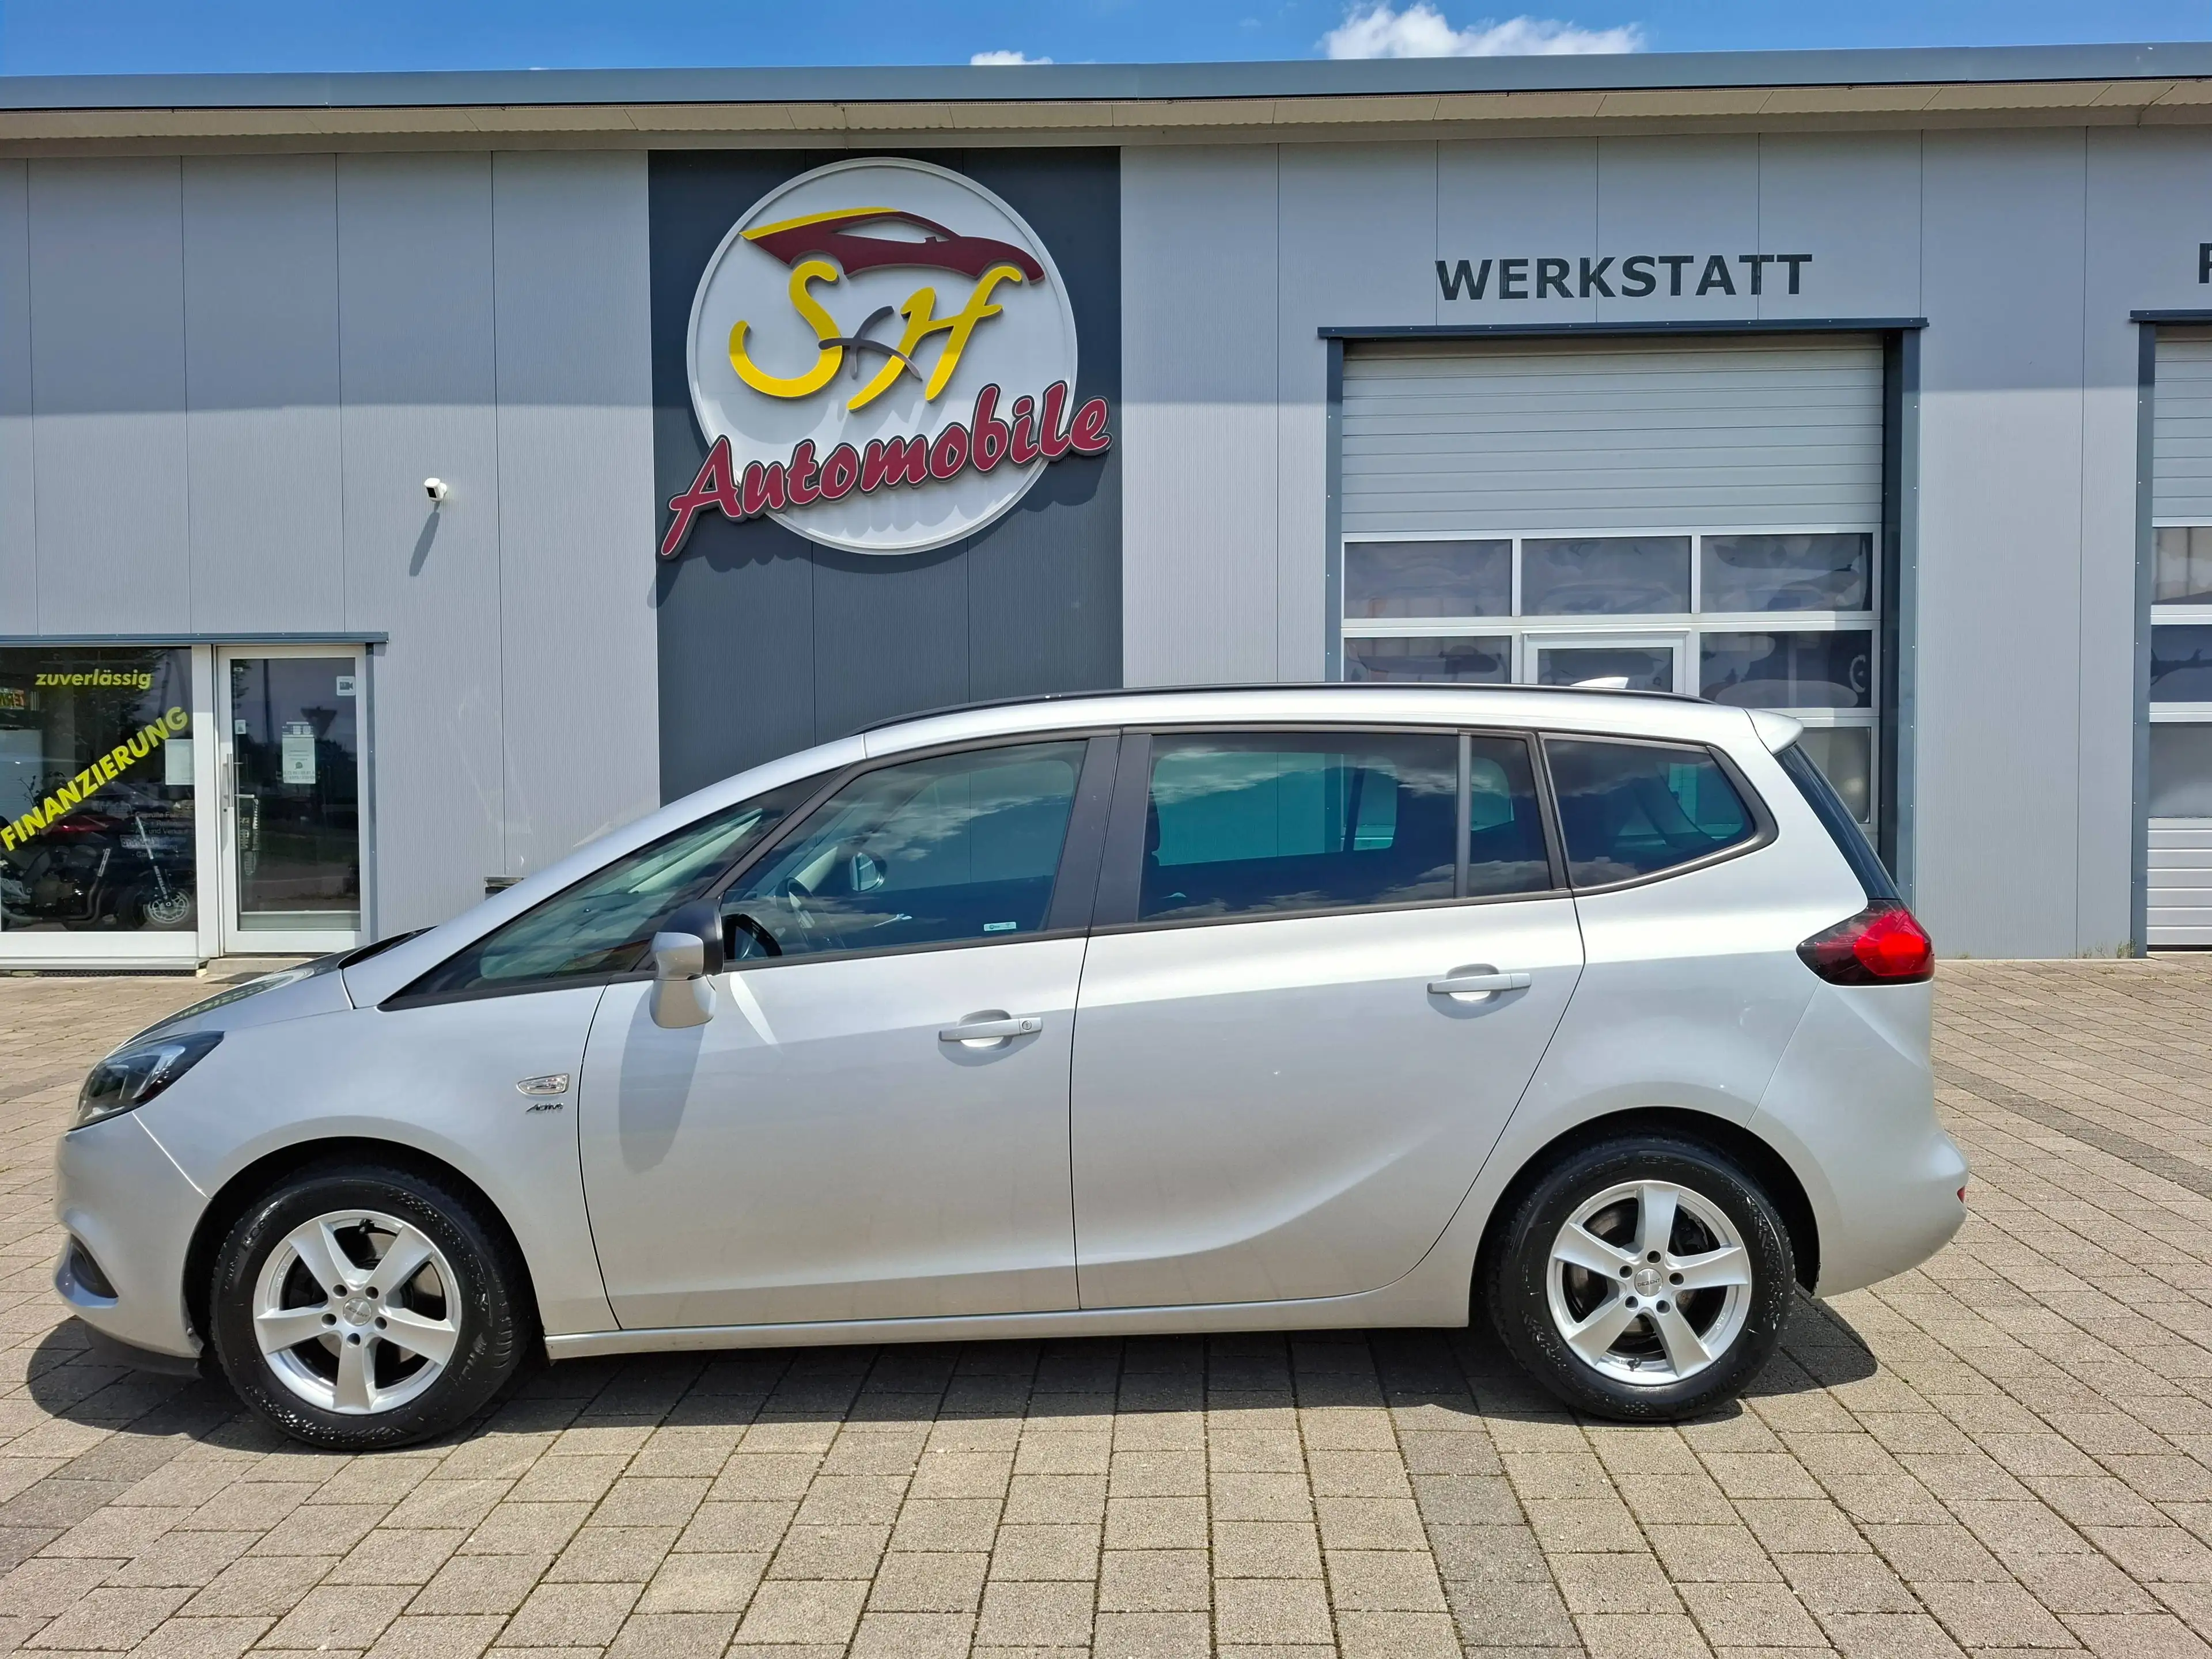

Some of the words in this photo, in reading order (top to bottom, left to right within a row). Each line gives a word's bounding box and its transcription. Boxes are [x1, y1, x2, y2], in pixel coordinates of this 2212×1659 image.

[1435, 253, 1813, 301] WERKSTATT
[656, 380, 1113, 560] Automobile
[35, 669, 152, 690] zuverlässig
[1, 706, 188, 851] FINANZIERUNG
